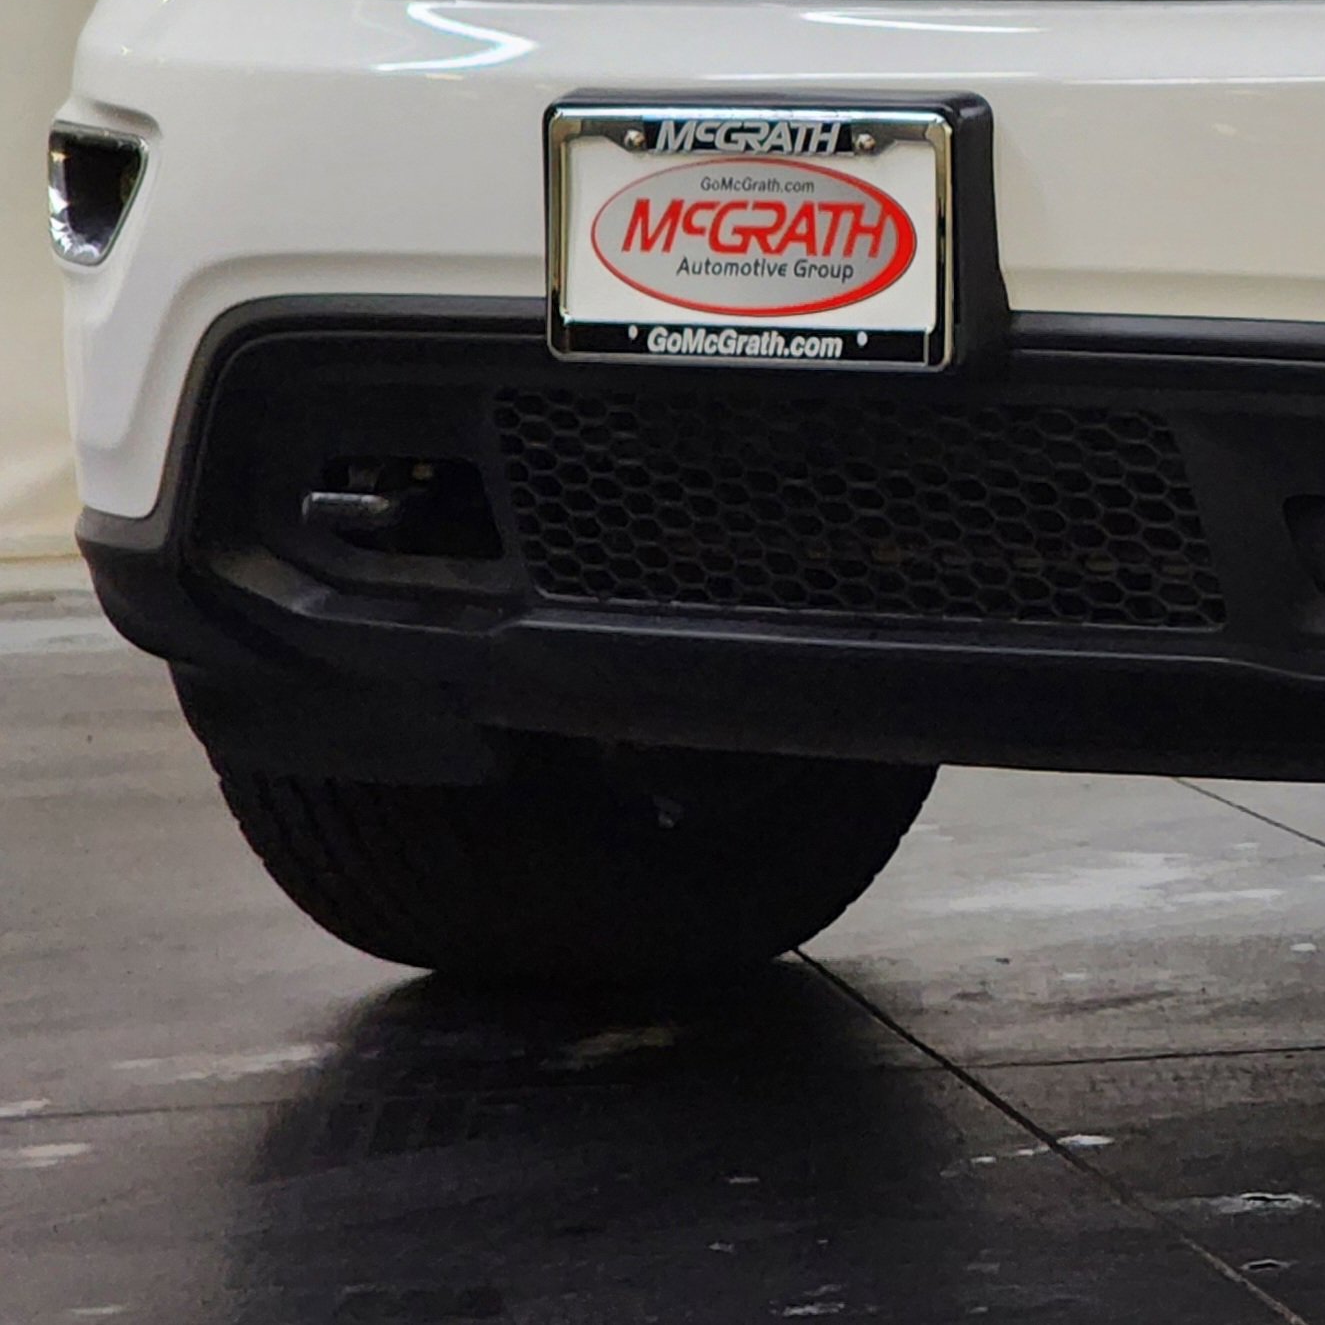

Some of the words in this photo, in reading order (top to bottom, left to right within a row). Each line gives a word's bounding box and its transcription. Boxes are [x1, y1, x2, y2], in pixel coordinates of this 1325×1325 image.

[700, 176, 816, 194] GoMcGrath.com
[676, 256, 788, 278] Automotive
[793, 258, 854, 283] Group
[646, 326, 843, 359] GoMcGrath.com
